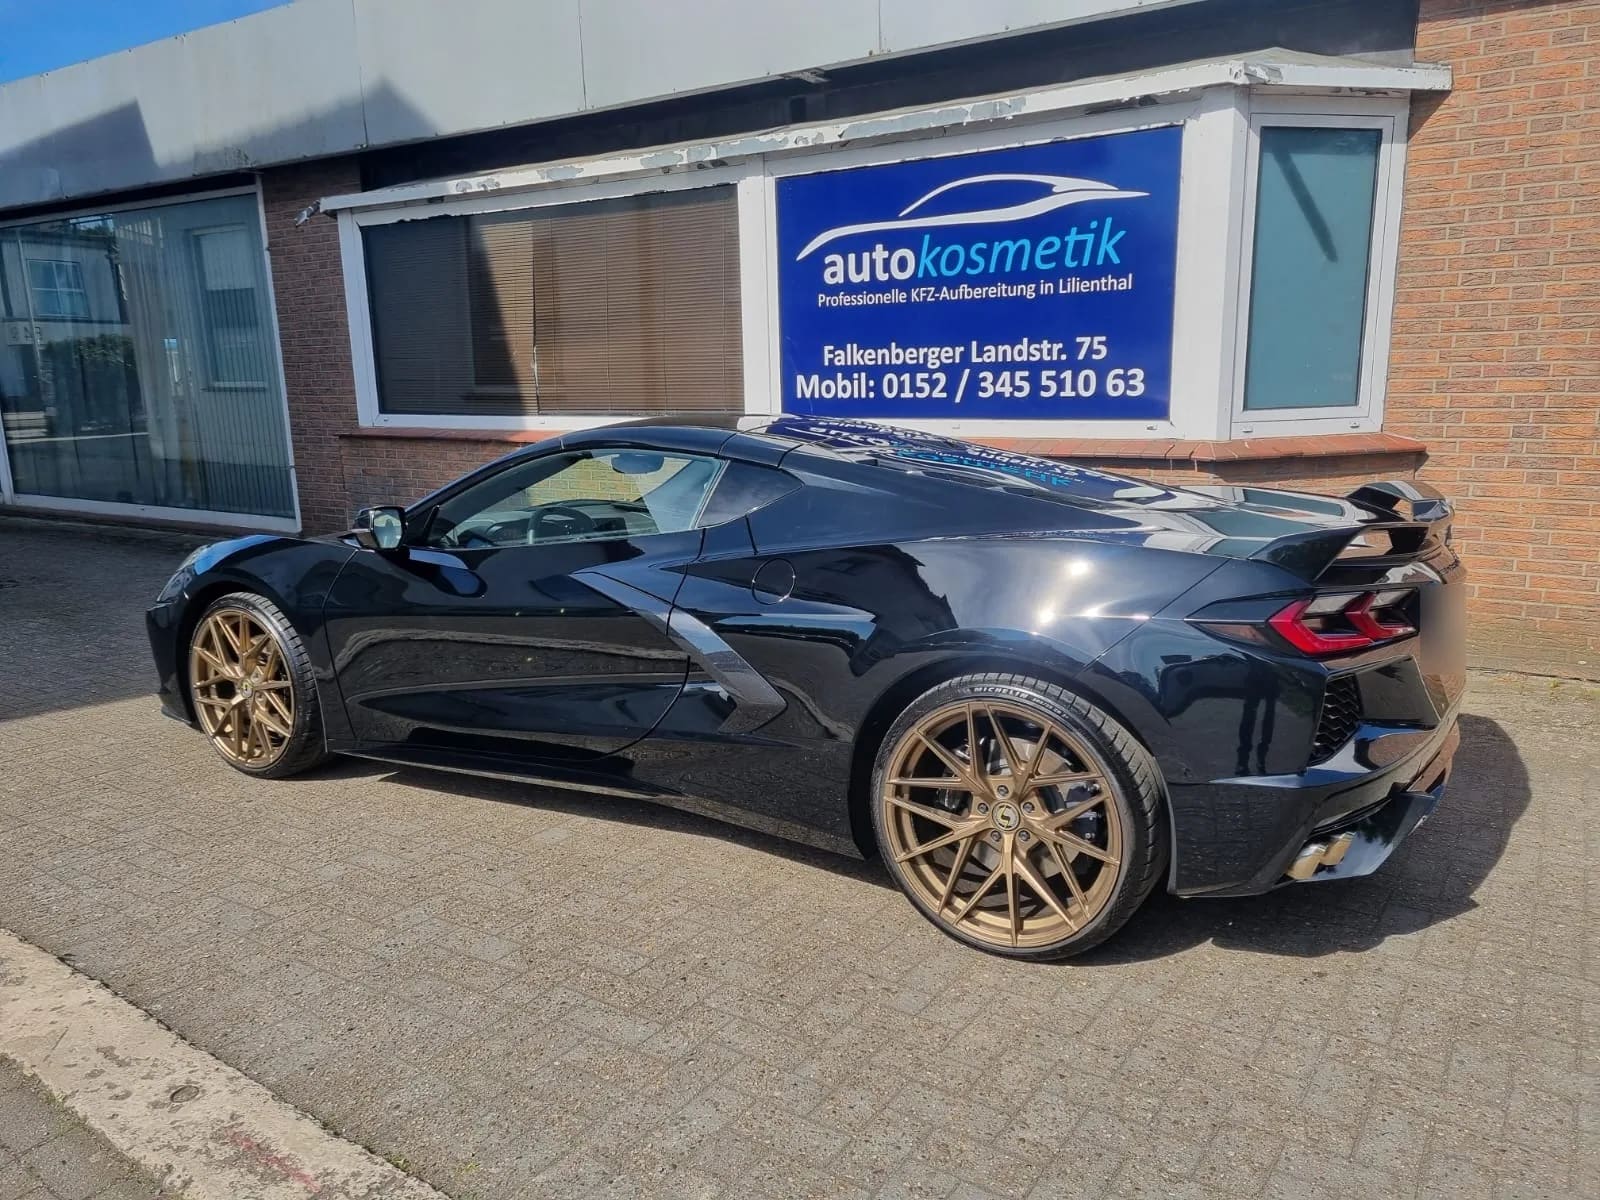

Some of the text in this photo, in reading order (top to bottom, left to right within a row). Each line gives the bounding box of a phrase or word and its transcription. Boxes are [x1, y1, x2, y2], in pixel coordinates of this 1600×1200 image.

[818, 273, 1133, 307] Professionelle KFZ-Aufbereitung in Lilienthal
[823, 335, 1108, 370] Falkenberger Landstr. 75
[796, 367, 1145, 404] Mobil: 0152 / 345 510 63
[973, 686, 1029, 700] MICHELIN
